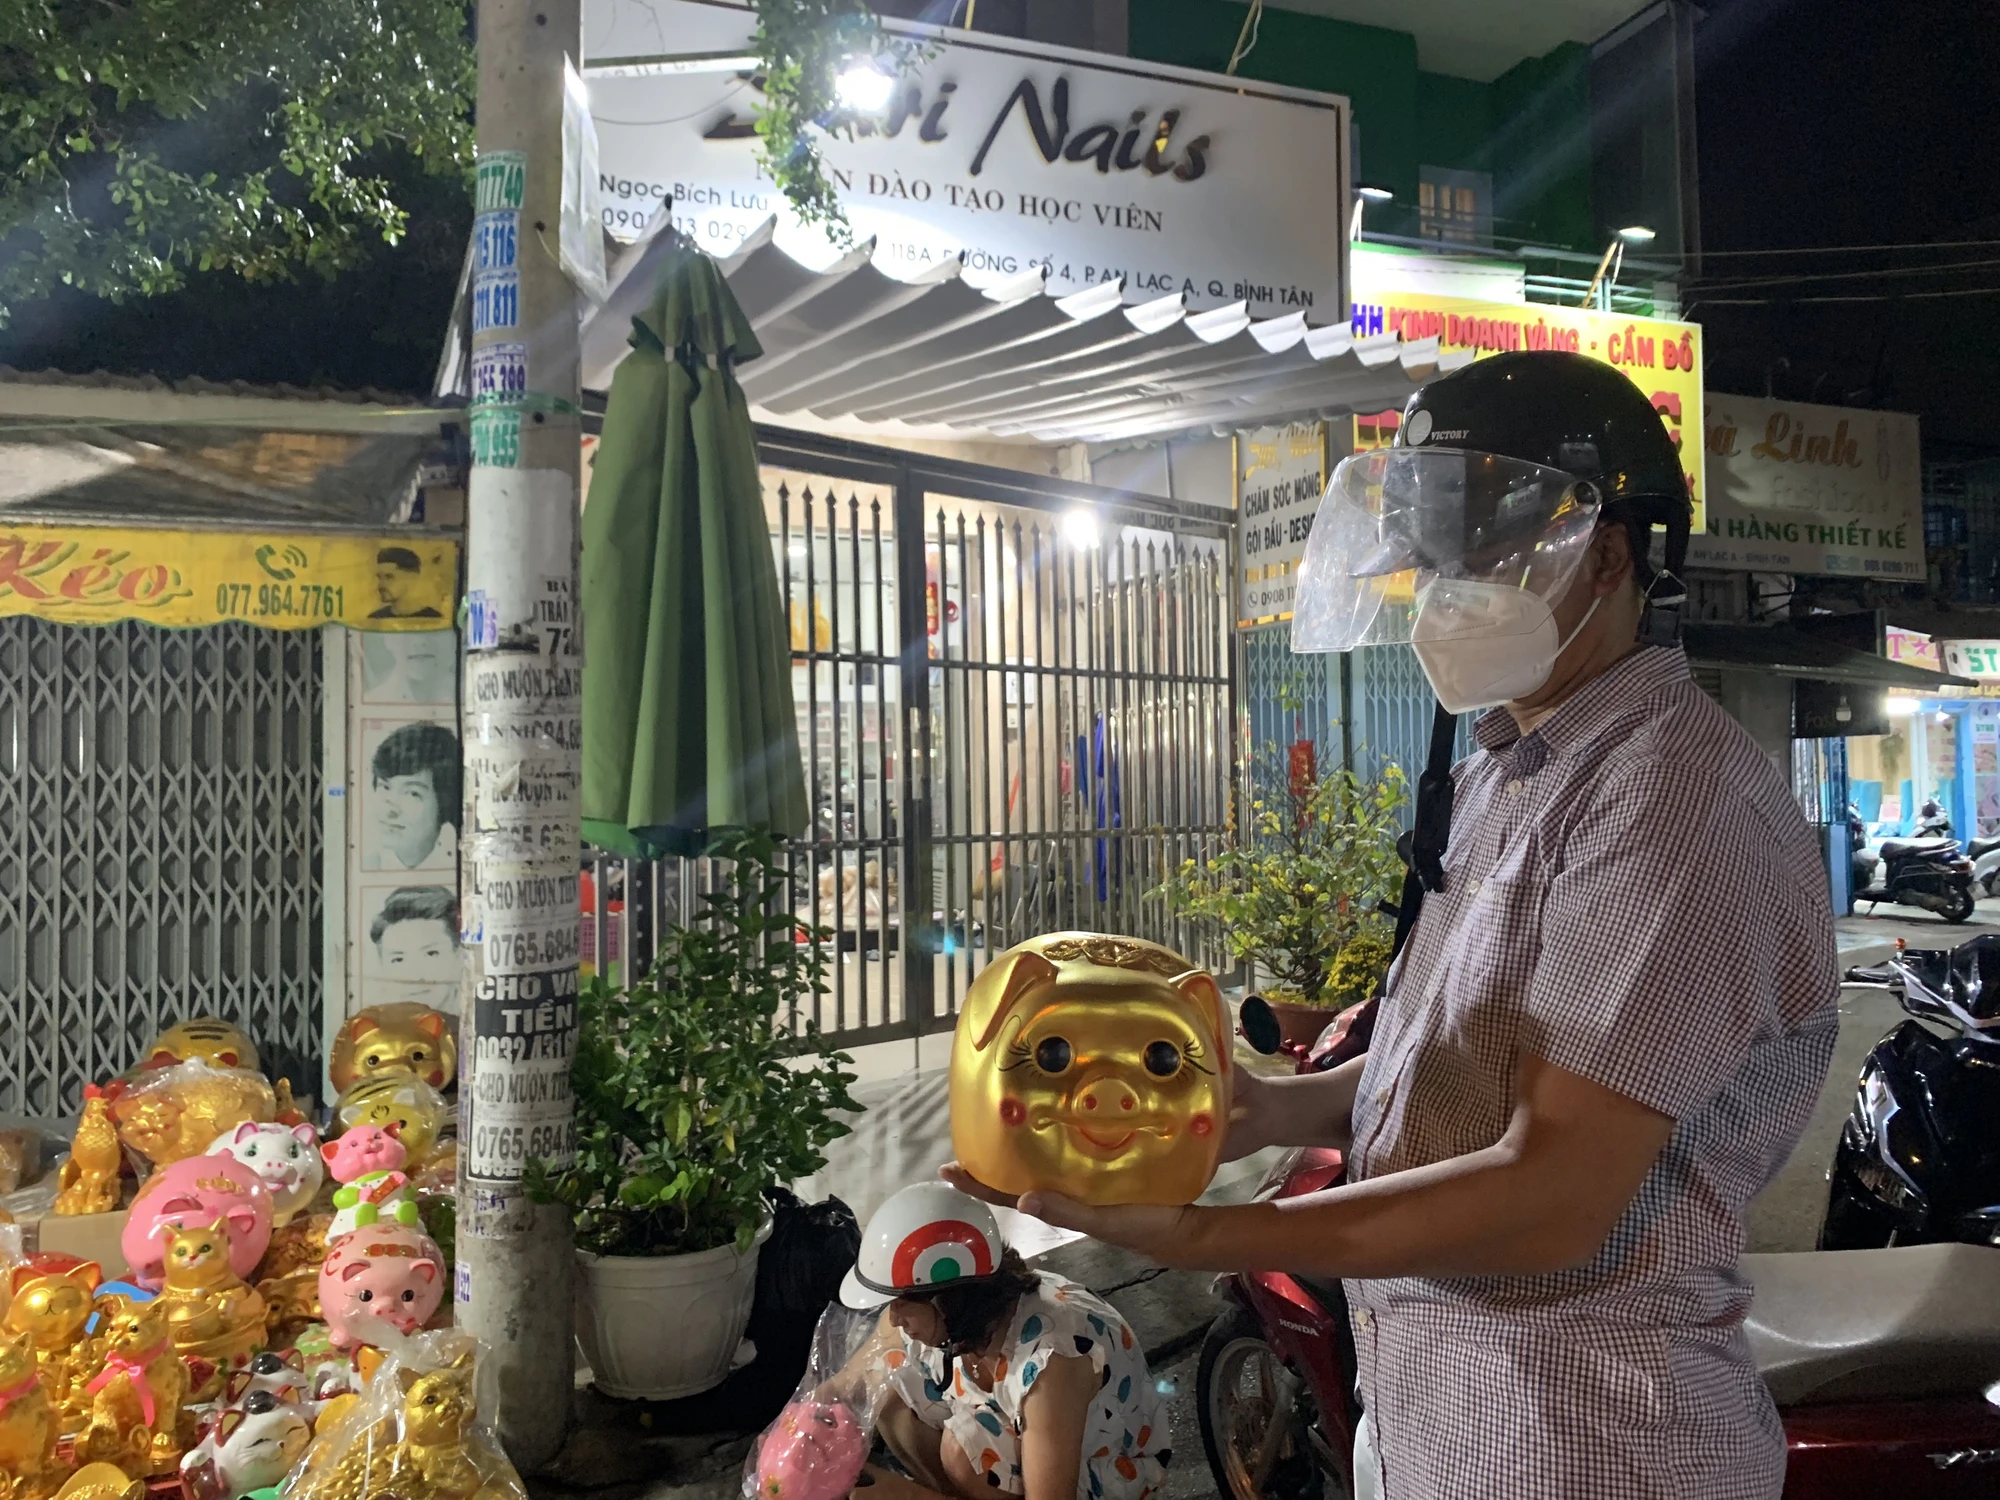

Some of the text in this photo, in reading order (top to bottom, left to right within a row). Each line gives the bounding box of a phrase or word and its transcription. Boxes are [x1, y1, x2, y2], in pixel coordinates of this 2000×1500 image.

[969, 75, 1210, 185] Nails
[600, 174, 768, 210] Ngọc Bích Lưu
[869, 170, 931, 202] ĐÀO
[944, 183, 1005, 214] TẠO
[1018, 193, 1081, 226] HỌC
[1093, 203, 1163, 232] VIÊN
[891, 242, 932, 263] 118A
[1137, 271, 1173, 294] LẠC
[1234, 278, 1274, 304] BÌNH
[1279, 284, 1314, 308] TÂN
[1390, 306, 1445, 343] KINH
[1449, 313, 1521, 352] DOANH
[1524, 317, 1580, 353] VÀNG
[1431, 429, 1470, 441] VICTORY
[1752, 411, 1863, 468] Linh
[1273, 477, 1291, 510] SÓC
[1294, 468, 1321, 503] MÓNG
[1246, 524, 1262, 559] GỘI
[1727, 513, 1799, 544] HÀNG
[1804, 517, 1872, 548] THIẾT
[1877, 522, 1907, 550] KẾ
[216, 583, 344, 619] 077.964.7761
[1261, 588, 1285, 606] 0908
[487, 880, 513, 911] CHO
[477, 975, 541, 1001] CHO
[479, 1072, 504, 1103] CHO
[507, 1067, 548, 1110] MƯỢN
[1279, 1319, 1320, 1337] HONDA
